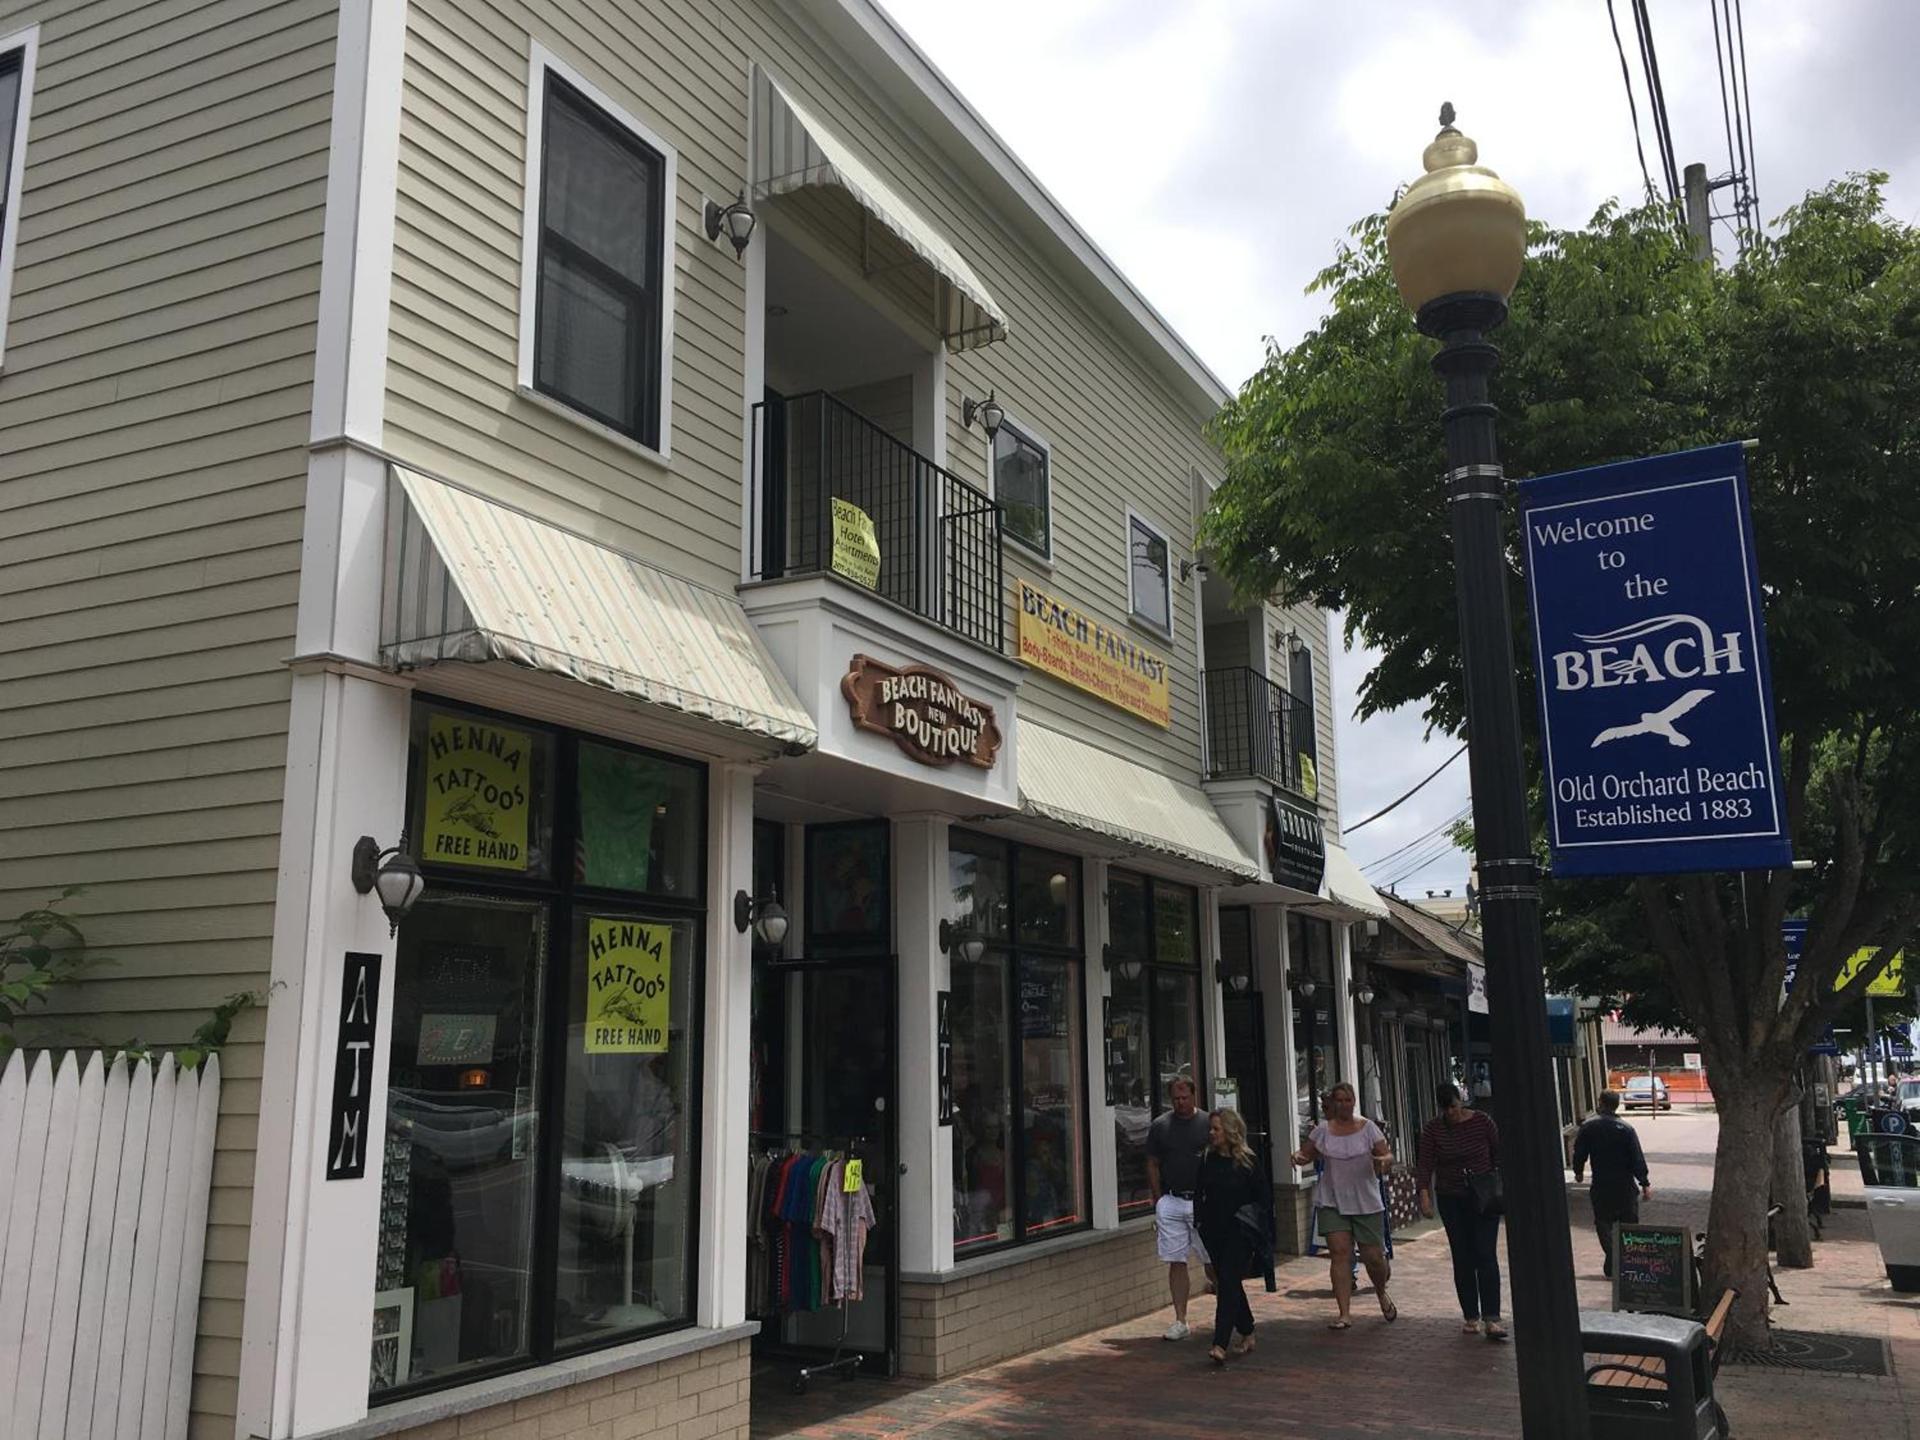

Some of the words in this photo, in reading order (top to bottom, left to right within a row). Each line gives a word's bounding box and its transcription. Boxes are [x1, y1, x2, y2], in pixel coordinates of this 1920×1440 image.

[1534, 512, 1656, 547] Welcome
[1599, 549, 1626, 571] to
[1625, 574, 1668, 600] the
[1022, 583, 1088, 644] BEACH
[1096, 624, 1165, 685] FANTASY
[1553, 614, 1745, 691] BEACH
[882, 676, 927, 703] BEACH
[930, 681, 986, 734] FANTASY
[928, 705, 947, 725] NEW
[895, 702, 978, 756] BOUTIQUE
[430, 726, 521, 772] HENNA
[433, 768, 524, 811] TATTOOS
[1558, 775, 1596, 802] Old
[1602, 769, 1690, 799] Orchard
[1698, 763, 1766, 793] Beach
[1575, 802, 1691, 828] Established
[1699, 798, 1752, 820] 1883
[435, 834, 471, 856] FREE
[477, 838, 519, 862] HAND
[590, 925, 663, 962] HENNA
[592, 964, 665, 999] TATTOOS
[595, 1027, 623, 1045] FREE
[627, 1028, 661, 1045] HAND
[1105, 1000, 1114, 1101] ATM
[333, 966, 371, 1170] ATM
[940, 999, 950, 1120] ATM
